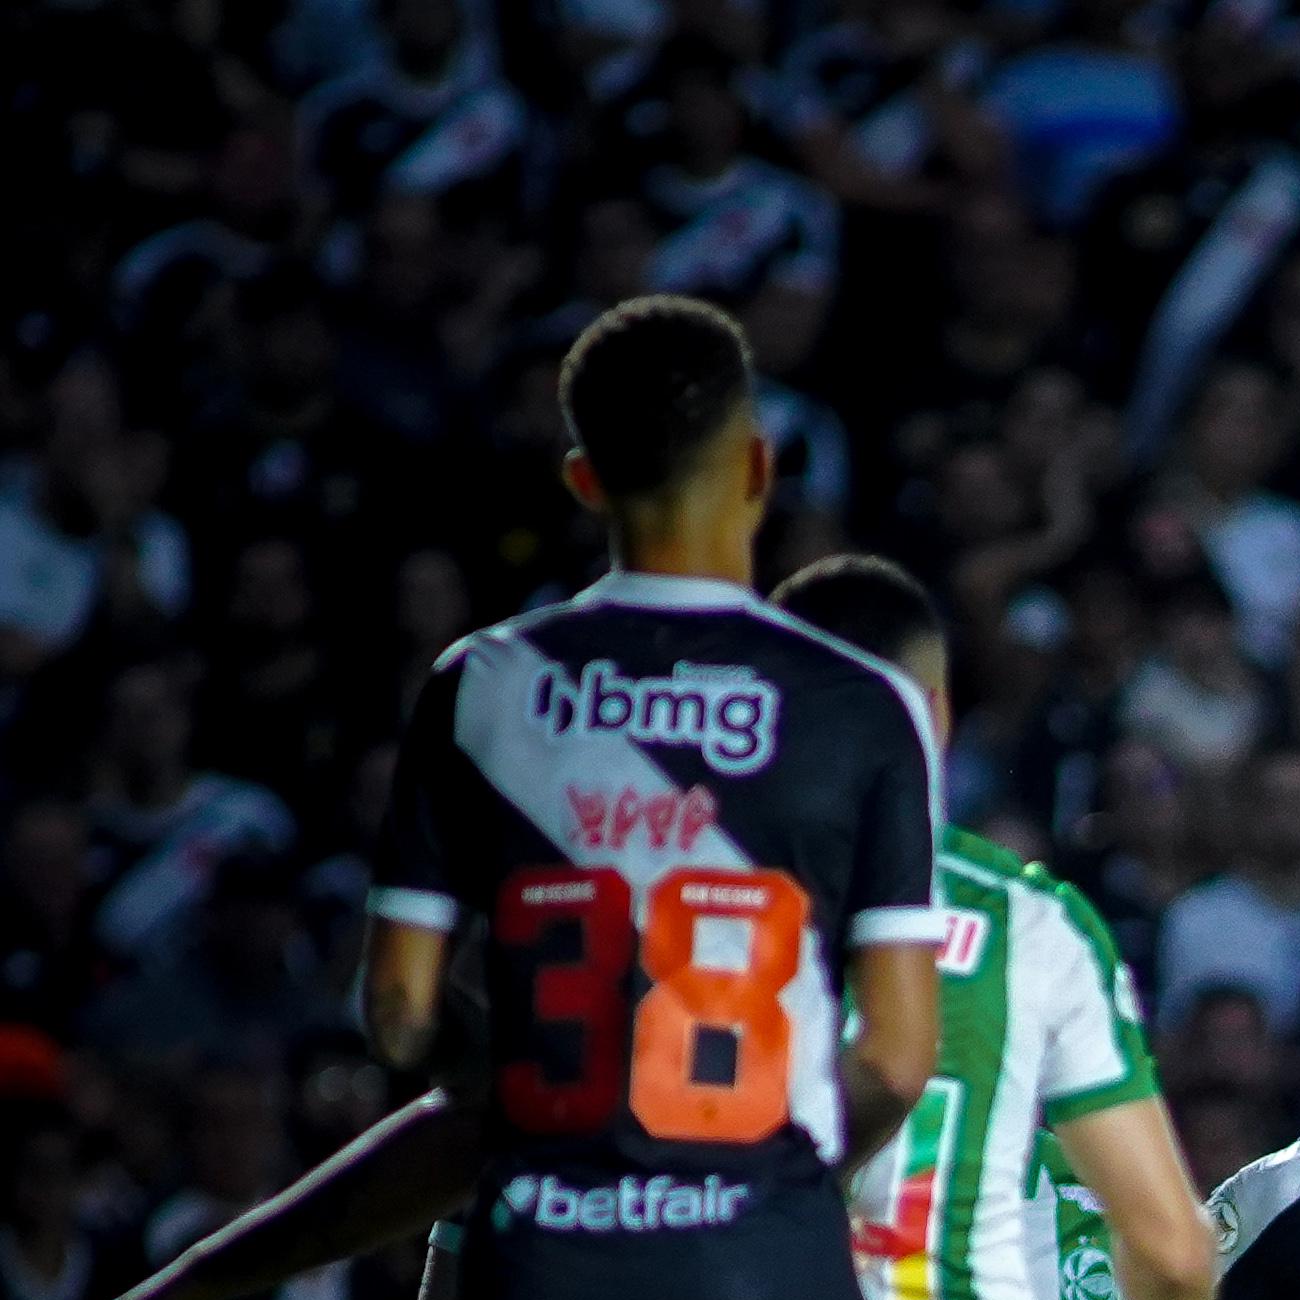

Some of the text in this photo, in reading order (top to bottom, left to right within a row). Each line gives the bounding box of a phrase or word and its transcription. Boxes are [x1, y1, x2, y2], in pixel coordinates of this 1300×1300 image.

[582, 663, 776, 770] bmg
[494, 866, 811, 1142] 38
[534, 1175, 750, 1231] betfair
